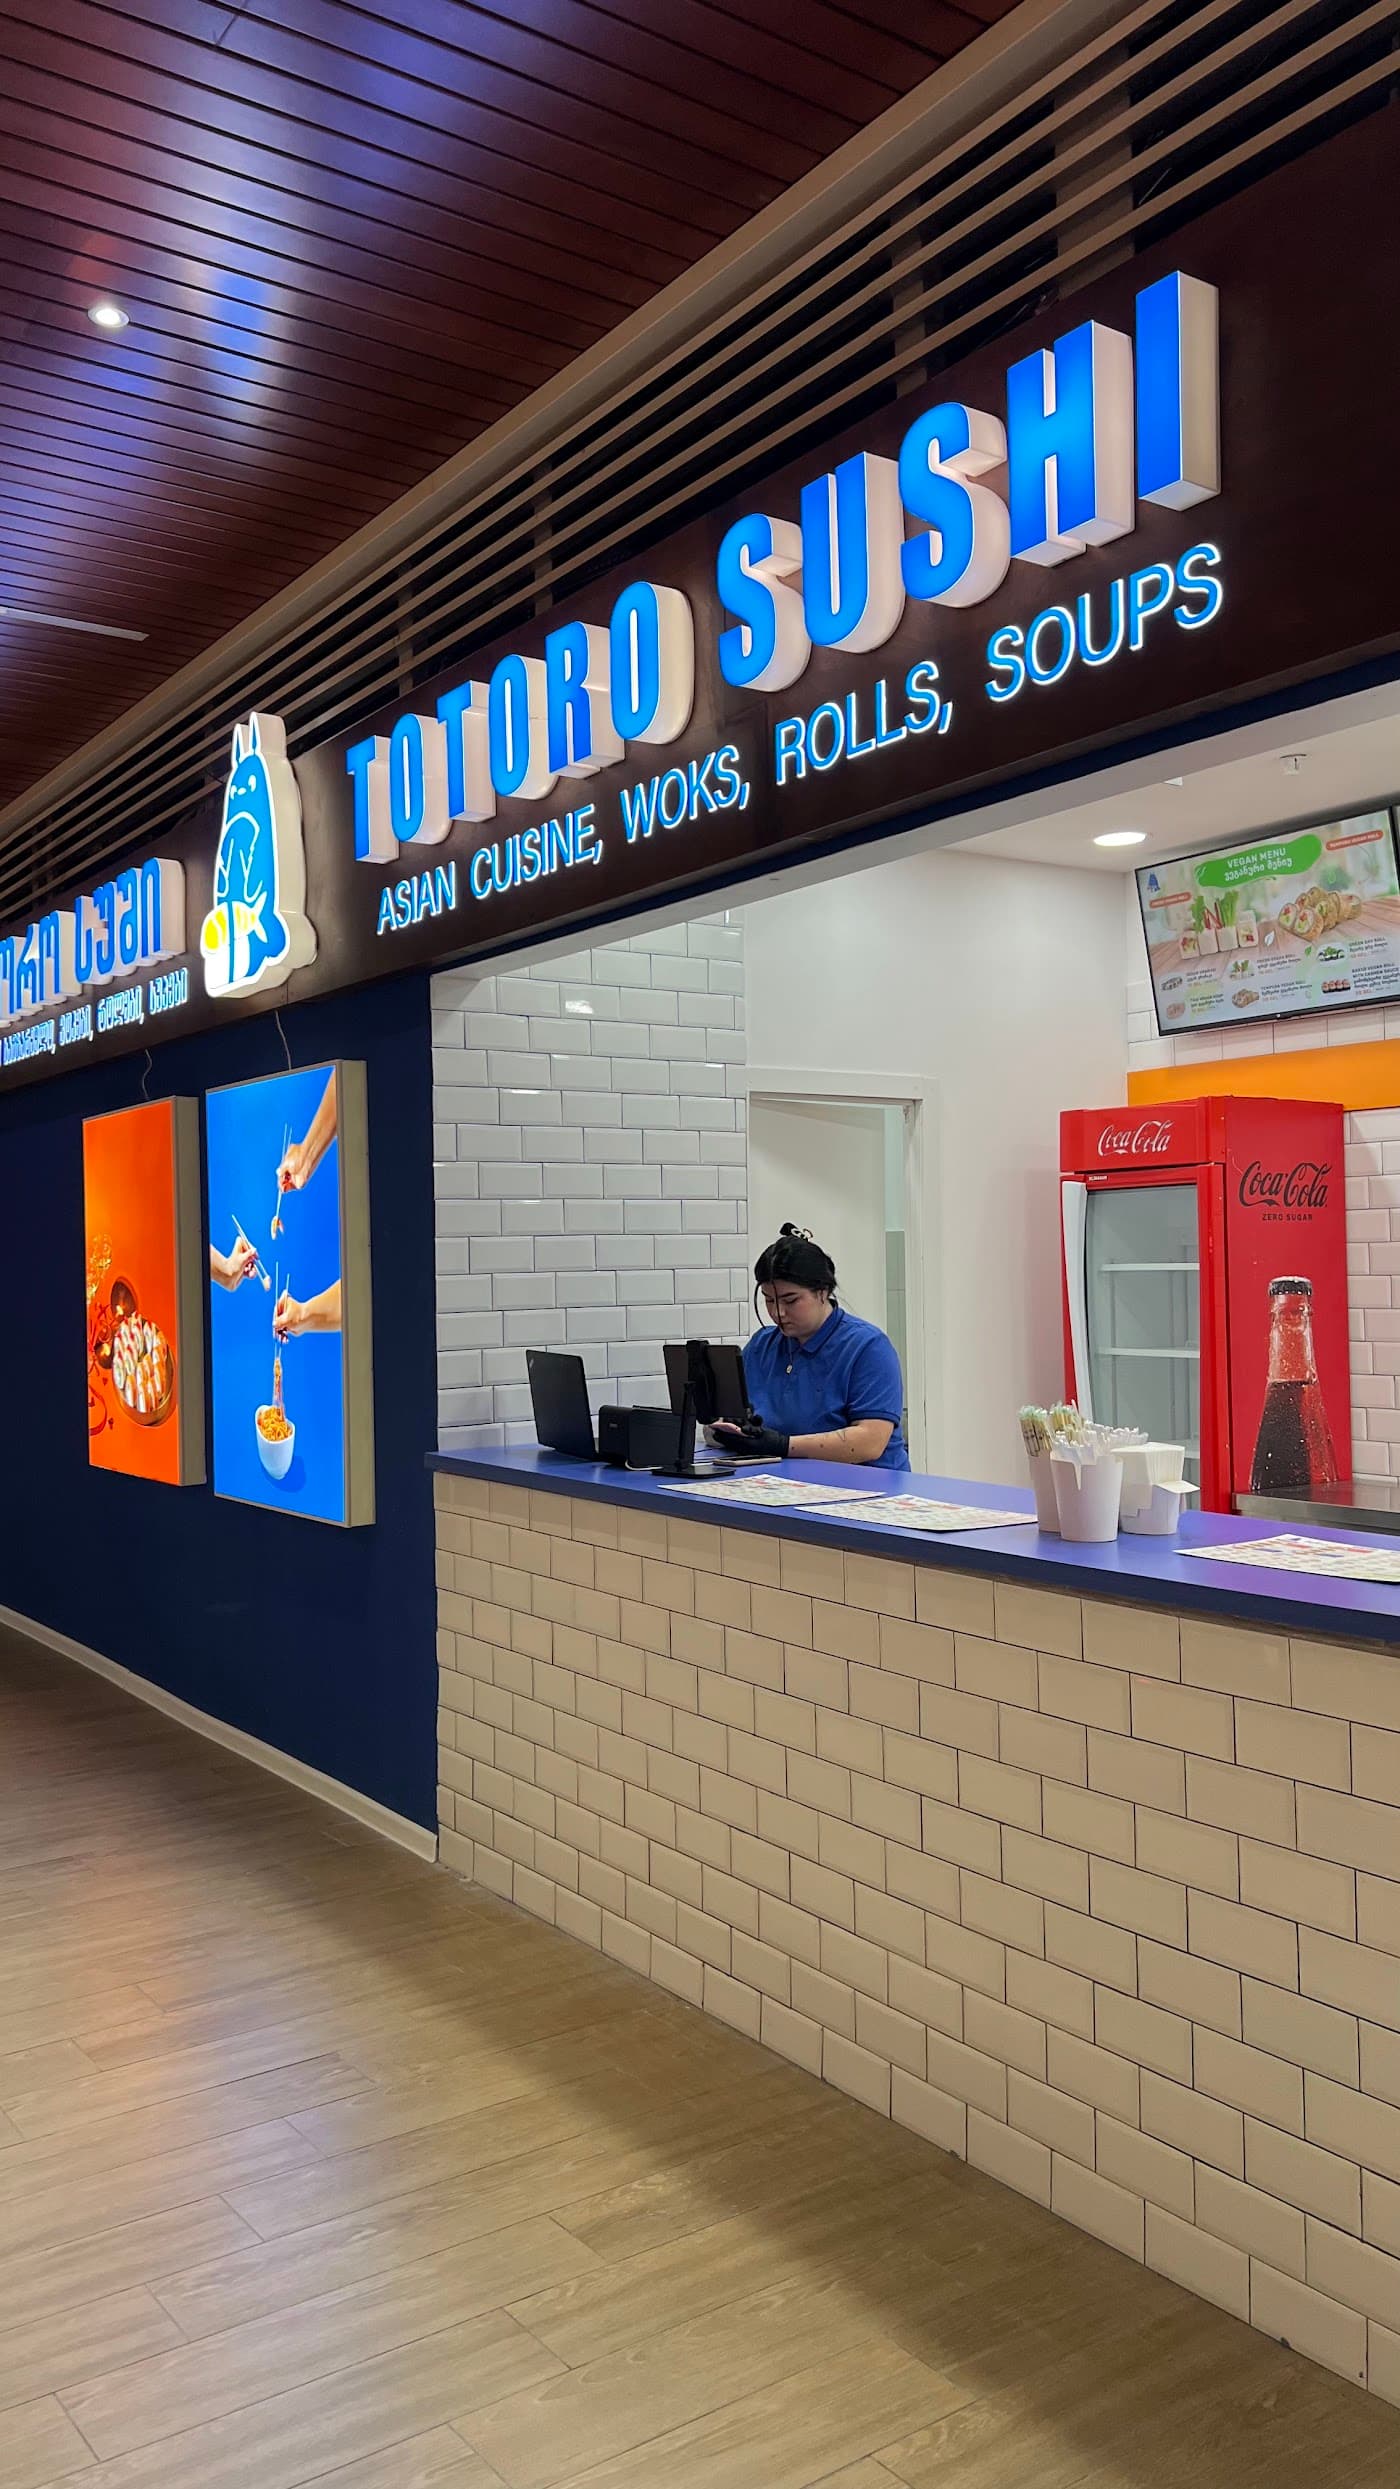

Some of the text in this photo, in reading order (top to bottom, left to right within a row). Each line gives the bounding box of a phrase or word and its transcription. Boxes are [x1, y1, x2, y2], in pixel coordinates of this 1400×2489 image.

[346, 270, 1185, 862] TOTORO SUSHI
[376, 542, 1223, 935] ASIAN CUISINE, WOKS, ROLLS, SOUPS
[1227, 847, 1286, 868] VEGAN MENU
[75, 857, 162, 983] სუში
[1097, 1119, 1174, 1156] Coca-Cola
[1239, 1160, 1332, 1208] Coca-Cola
[1262, 1213, 1313, 1221] ZERO SUGAR
